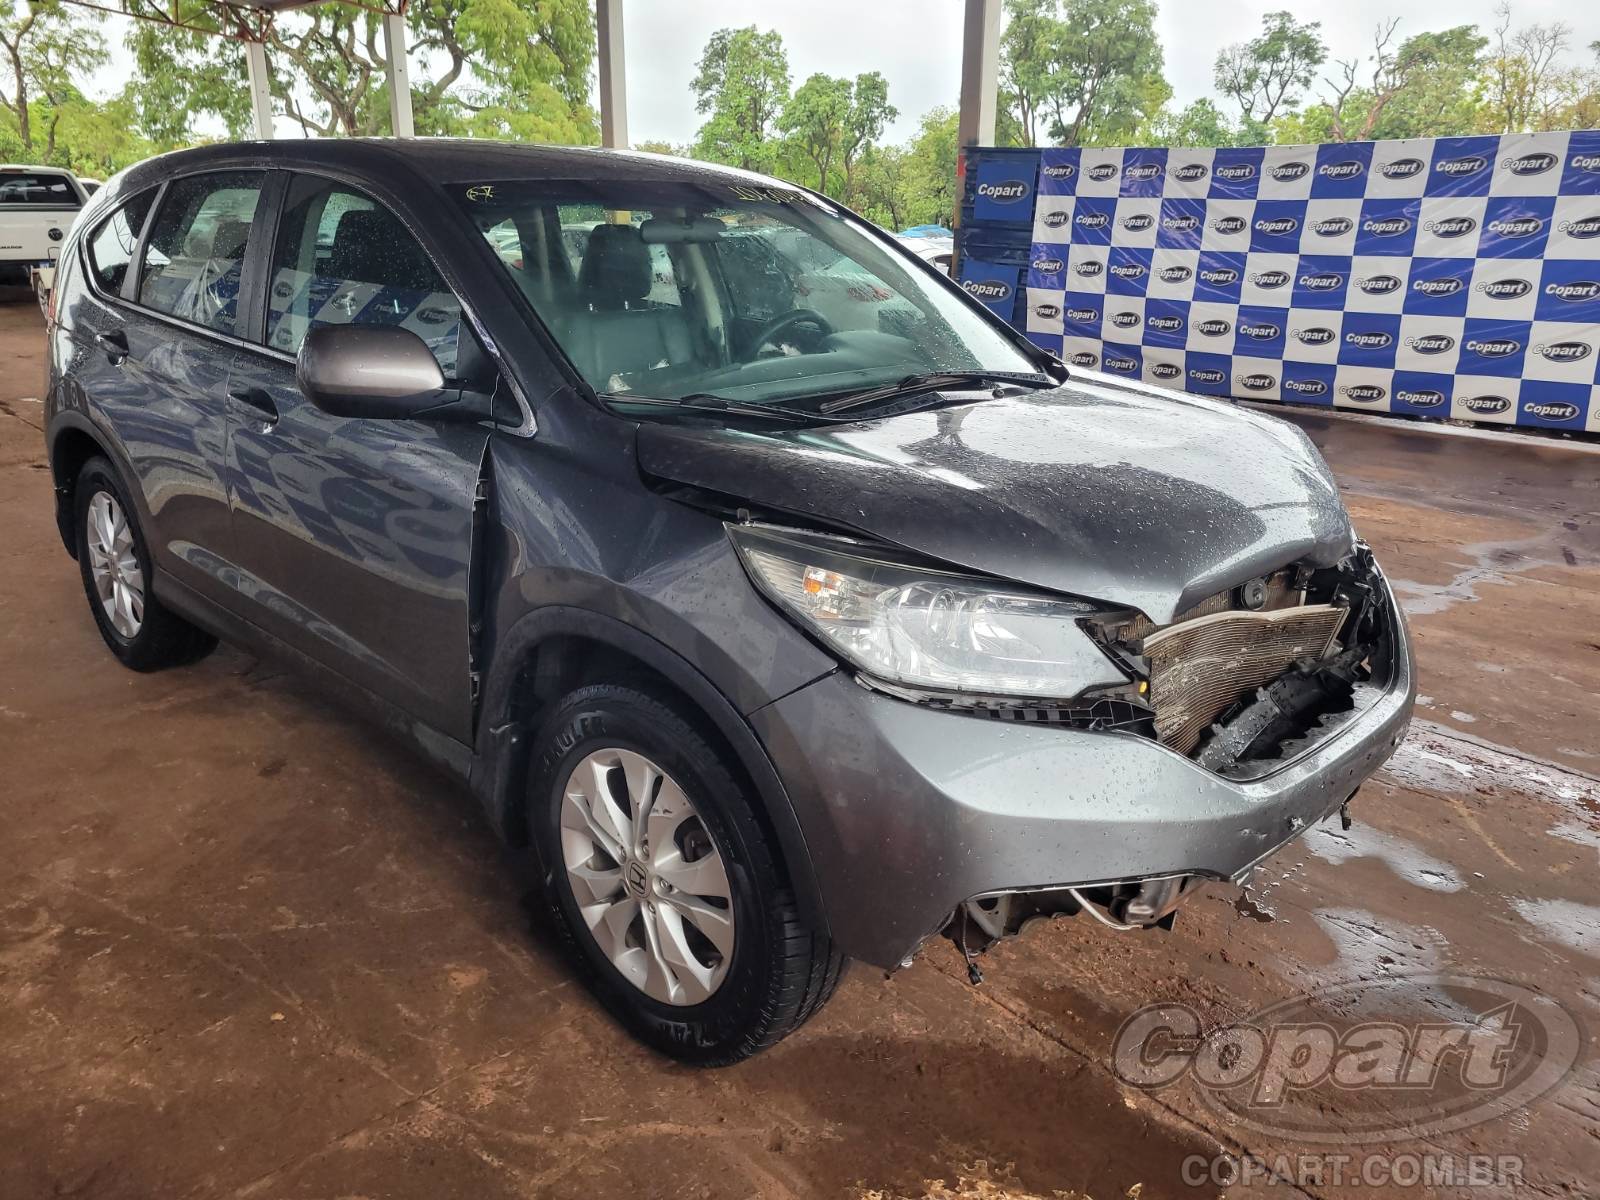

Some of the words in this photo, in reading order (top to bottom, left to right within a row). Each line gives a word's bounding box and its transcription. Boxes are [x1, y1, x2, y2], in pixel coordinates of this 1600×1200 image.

[1319, 164, 1359, 176] Copart
[1376, 163, 1420, 176] Copart
[1436, 160, 1482, 173] Copart
[1502, 157, 1553, 172] Copart
[1043, 166, 1071, 176] Copart
[1083, 166, 1113, 176] Copart
[1126, 166, 1158, 176] Copart
[1171, 166, 1204, 177] Copart
[1216, 166, 1250, 177] Copart
[1267, 164, 1305, 177] Copart
[978, 184, 1023, 198] Copart
[1041, 213, 1065, 224] Copart
[1076, 215, 1105, 225] Copart
[1119, 217, 1150, 227] Copart
[1163, 217, 1196, 228] Copart
[1210, 219, 1242, 229] Copart
[1255, 220, 1293, 231] Copart
[1309, 221, 1348, 232] Copart
[1363, 220, 1406, 232] Copart
[1424, 220, 1471, 233] Copart
[1488, 220, 1538, 234] Copart
[1558, 221, 1600, 234] Copar
[1033, 260, 1060, 271] Copart
[1072, 263, 1099, 273] Copart
[1111, 265, 1141, 276] Copart
[1156, 268, 1188, 279] Copart
[1200, 270, 1233, 281] Copart
[1249, 273, 1286, 285] Copart
[1299, 275, 1338, 287] Copart
[1354, 278, 1397, 290] Copart
[1413, 280, 1459, 292] Copart
[963, 280, 1005, 296] Copart
[1476, 282, 1527, 294] Copart
[1546, 284, 1597, 297] Copart
[1032, 305, 1056, 316] Copart
[1067, 309, 1095, 320] Copart
[1107, 314, 1136, 324] Copart
[1148, 317, 1180, 328] Copart
[1193, 321, 1226, 332] Copart
[1240, 325, 1275, 337] Copart
[1291, 330, 1331, 341] Copart
[1346, 333, 1388, 346] Copart
[1405, 337, 1450, 350] Copart
[1467, 341, 1514, 354] Copart
[1533, 344, 1584, 358] Copart
[1067, 354, 1095, 363] Copart
[1105, 358, 1134, 369] Copart
[1148, 363, 1178, 374] Copart
[1190, 369, 1222, 381] Copart
[1236, 376, 1271, 387] Copart
[1286, 380, 1324, 391] Copart
[1340, 386, 1381, 399] Copart
[1397, 391, 1440, 403] Copart
[1459, 397, 1506, 410] Copart
[1524, 403, 1575, 418] Copart
